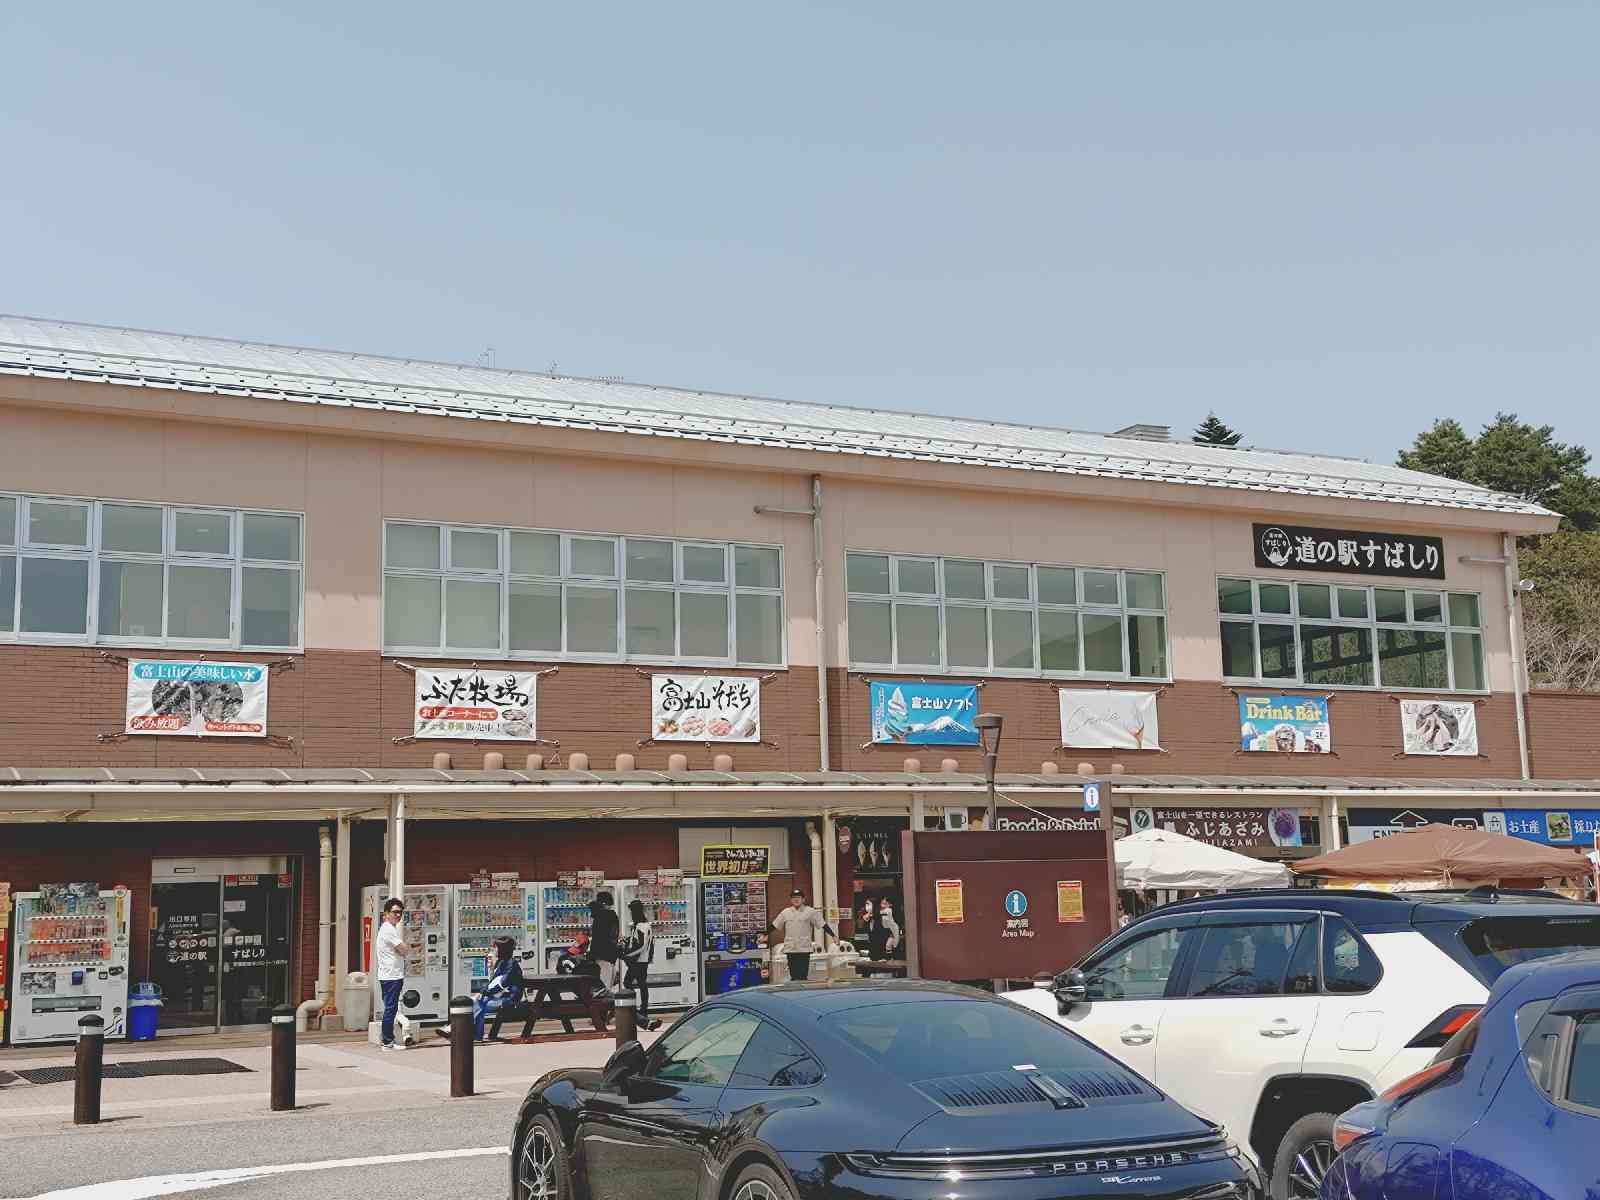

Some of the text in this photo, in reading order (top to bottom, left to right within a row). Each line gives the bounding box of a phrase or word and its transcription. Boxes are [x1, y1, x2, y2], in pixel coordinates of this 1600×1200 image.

[1294, 535, 1439, 572] 道の駅すばしり
[421, 674, 529, 706] ぶた牧場
[660, 678, 751, 711] 富士山そだち
[911, 695, 974, 711] 富士山ソフト
[1245, 703, 1322, 721] Drink Bar
[1156, 810, 1264, 820] 富士山を一望できるレストラン
[1185, 820, 1265, 837] ふじあざみ
[1508, 819, 1541, 834] お土産
[1053, 1153, 1182, 1174] PORSCHE
